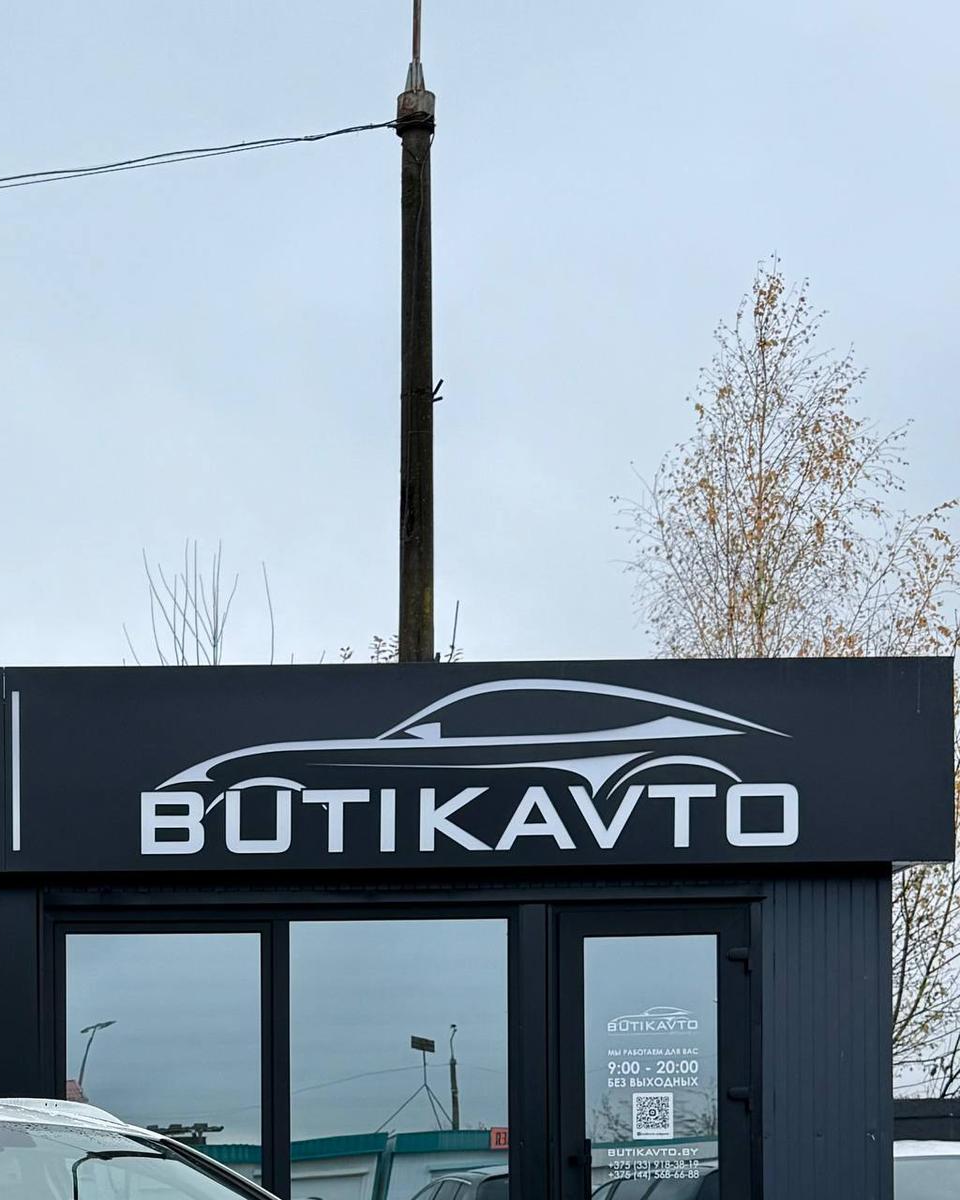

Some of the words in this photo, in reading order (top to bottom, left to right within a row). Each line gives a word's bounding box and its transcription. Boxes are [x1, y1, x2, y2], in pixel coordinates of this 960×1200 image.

[140, 782, 800, 855] BUTIKAVTO
[607, 1020, 698, 1032] BUTIKAVTO
[608, 1060, 640, 1075] 9:00
[656, 1060, 699, 1074] 20:00
[607, 1078, 626, 1088] БЕЗ
[629, 1076, 698, 1088] ВЫХОДНЫХ
[608, 1148, 699, 1157] BUTIKAVTO.BY
[608, 1161, 631, 1170] +375
[634, 1160, 651, 1172] (33)
[608, 1171, 631, 1179] +375
